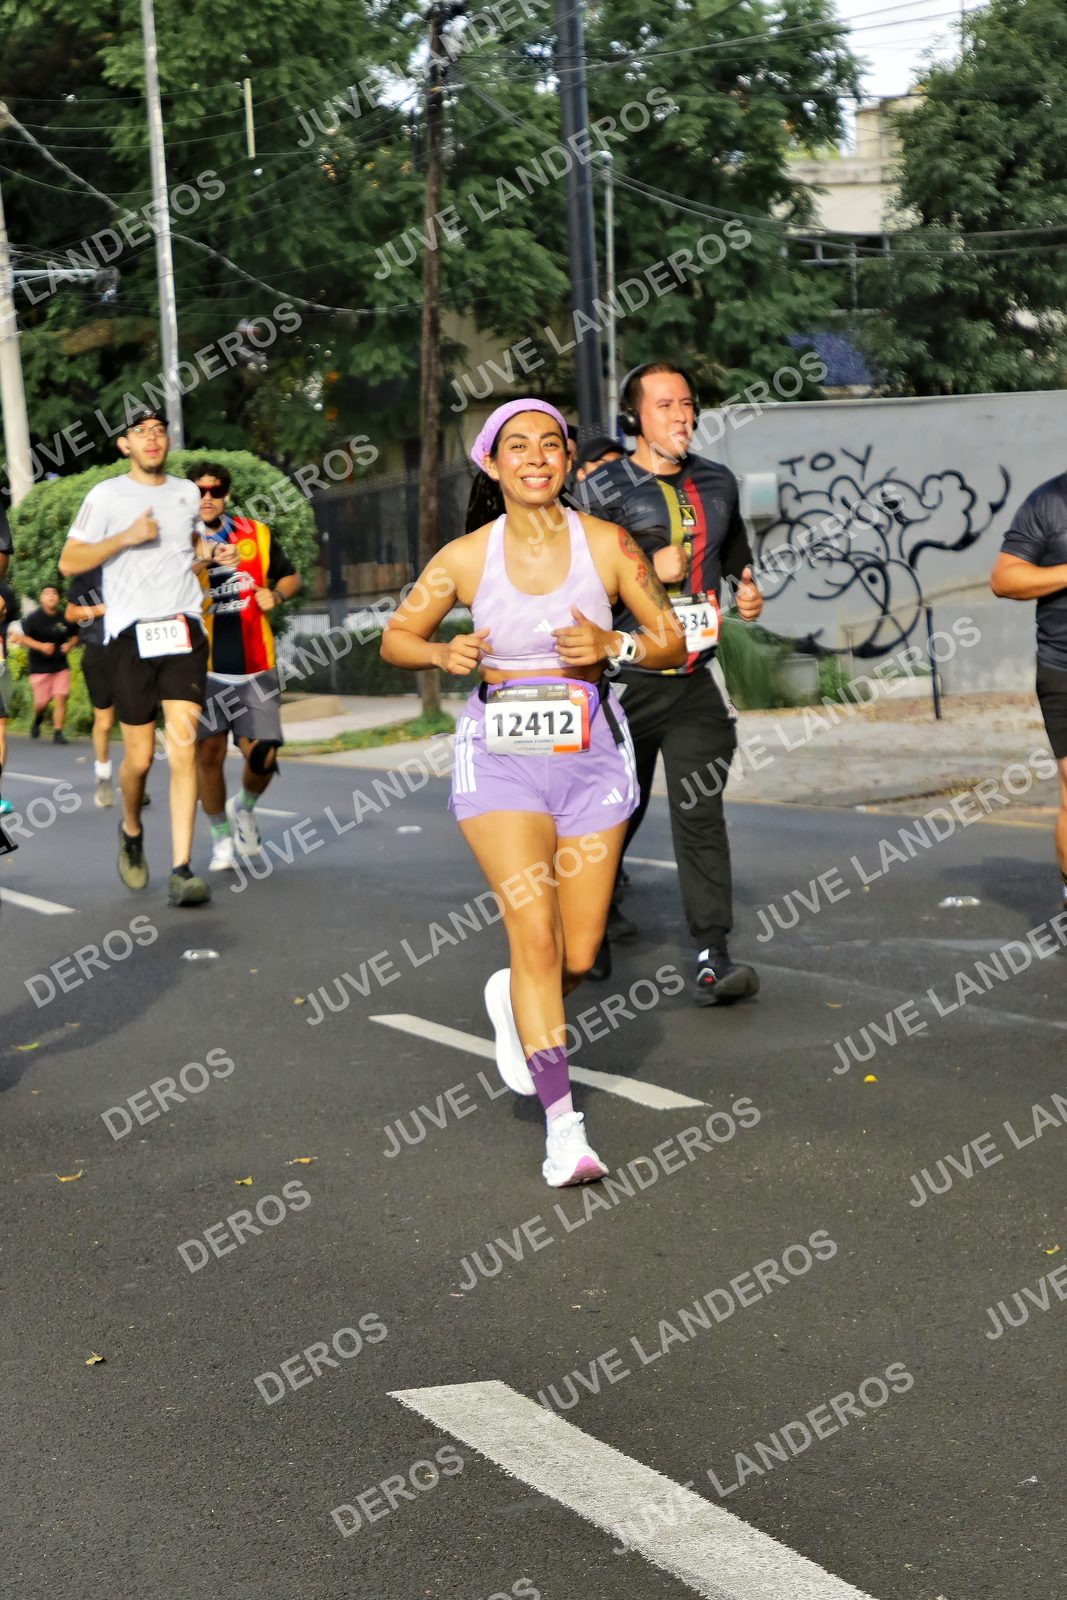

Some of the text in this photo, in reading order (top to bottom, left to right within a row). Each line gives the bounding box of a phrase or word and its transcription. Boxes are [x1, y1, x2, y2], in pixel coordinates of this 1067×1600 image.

[779, 444, 872, 482] TOY
[145, 626, 177, 642] 8510
[492, 710, 574, 737] 12412
